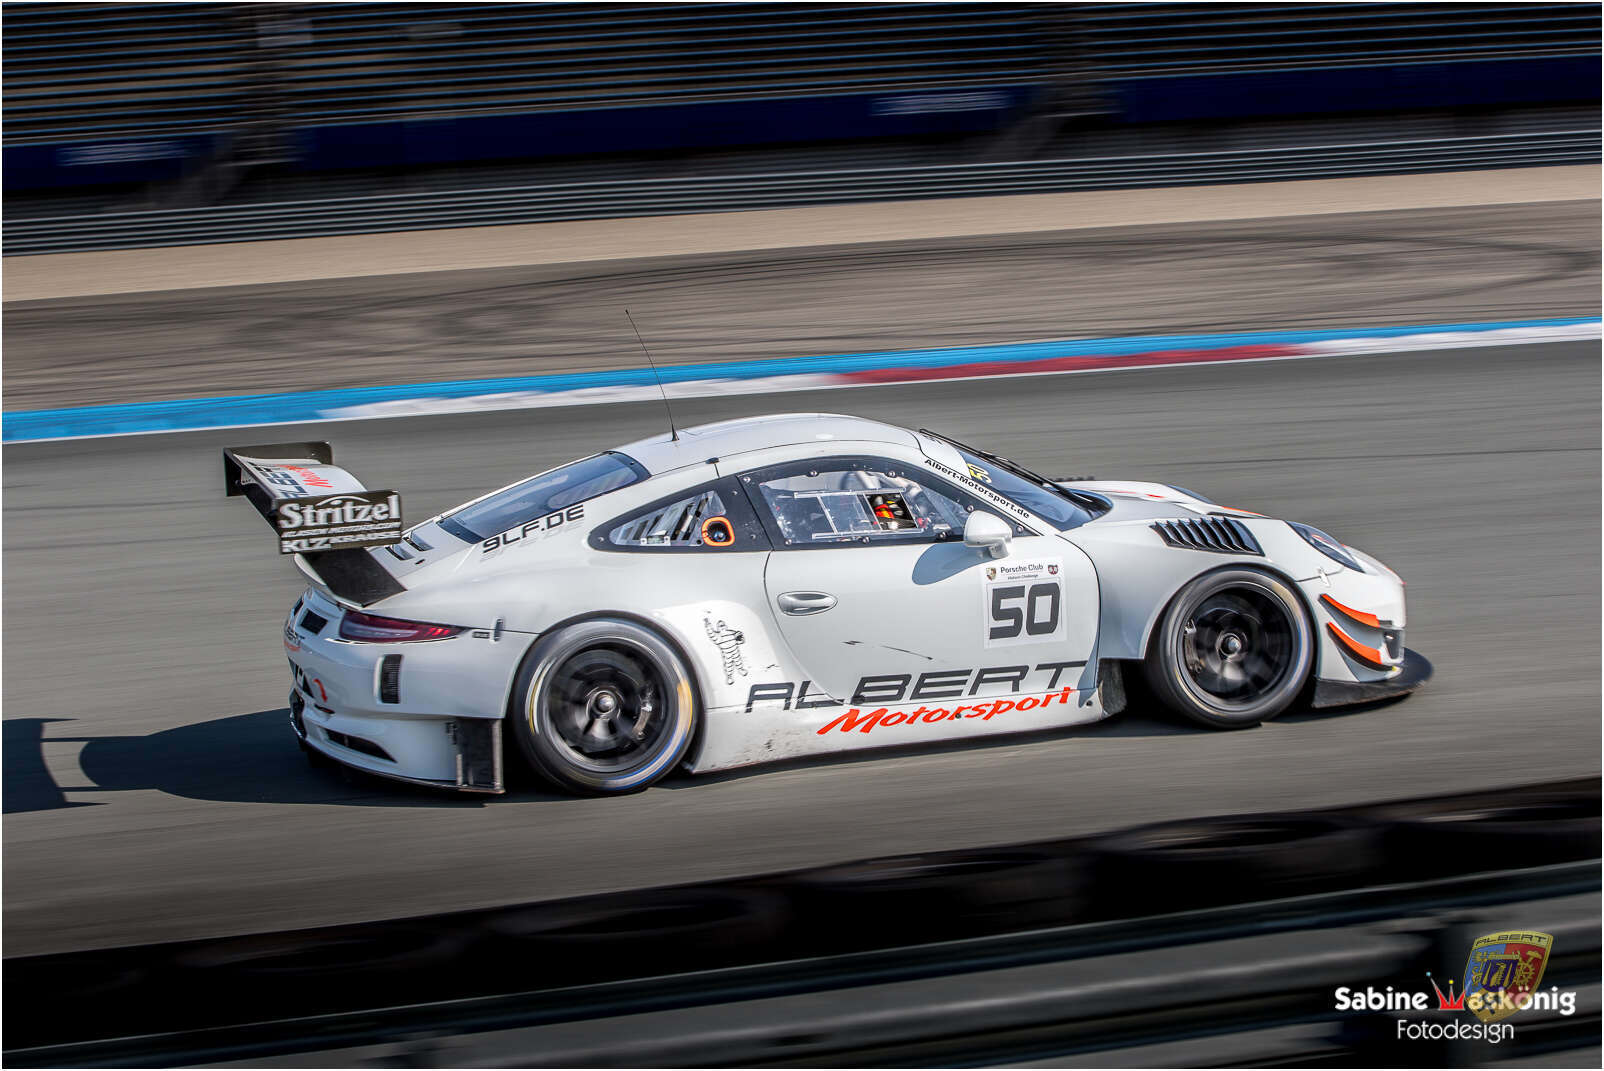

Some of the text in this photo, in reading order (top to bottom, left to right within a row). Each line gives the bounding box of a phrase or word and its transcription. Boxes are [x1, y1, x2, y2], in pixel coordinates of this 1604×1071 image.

[279, 494, 400, 529] Stritzel
[924, 459, 1030, 519] Albert-Motorsport.de
[1000, 563, 1044, 573] Porsche Club
[989, 582, 1061, 640] 50
[744, 660, 1089, 713] ALBERT
[816, 686, 1079, 735] Motorsport
